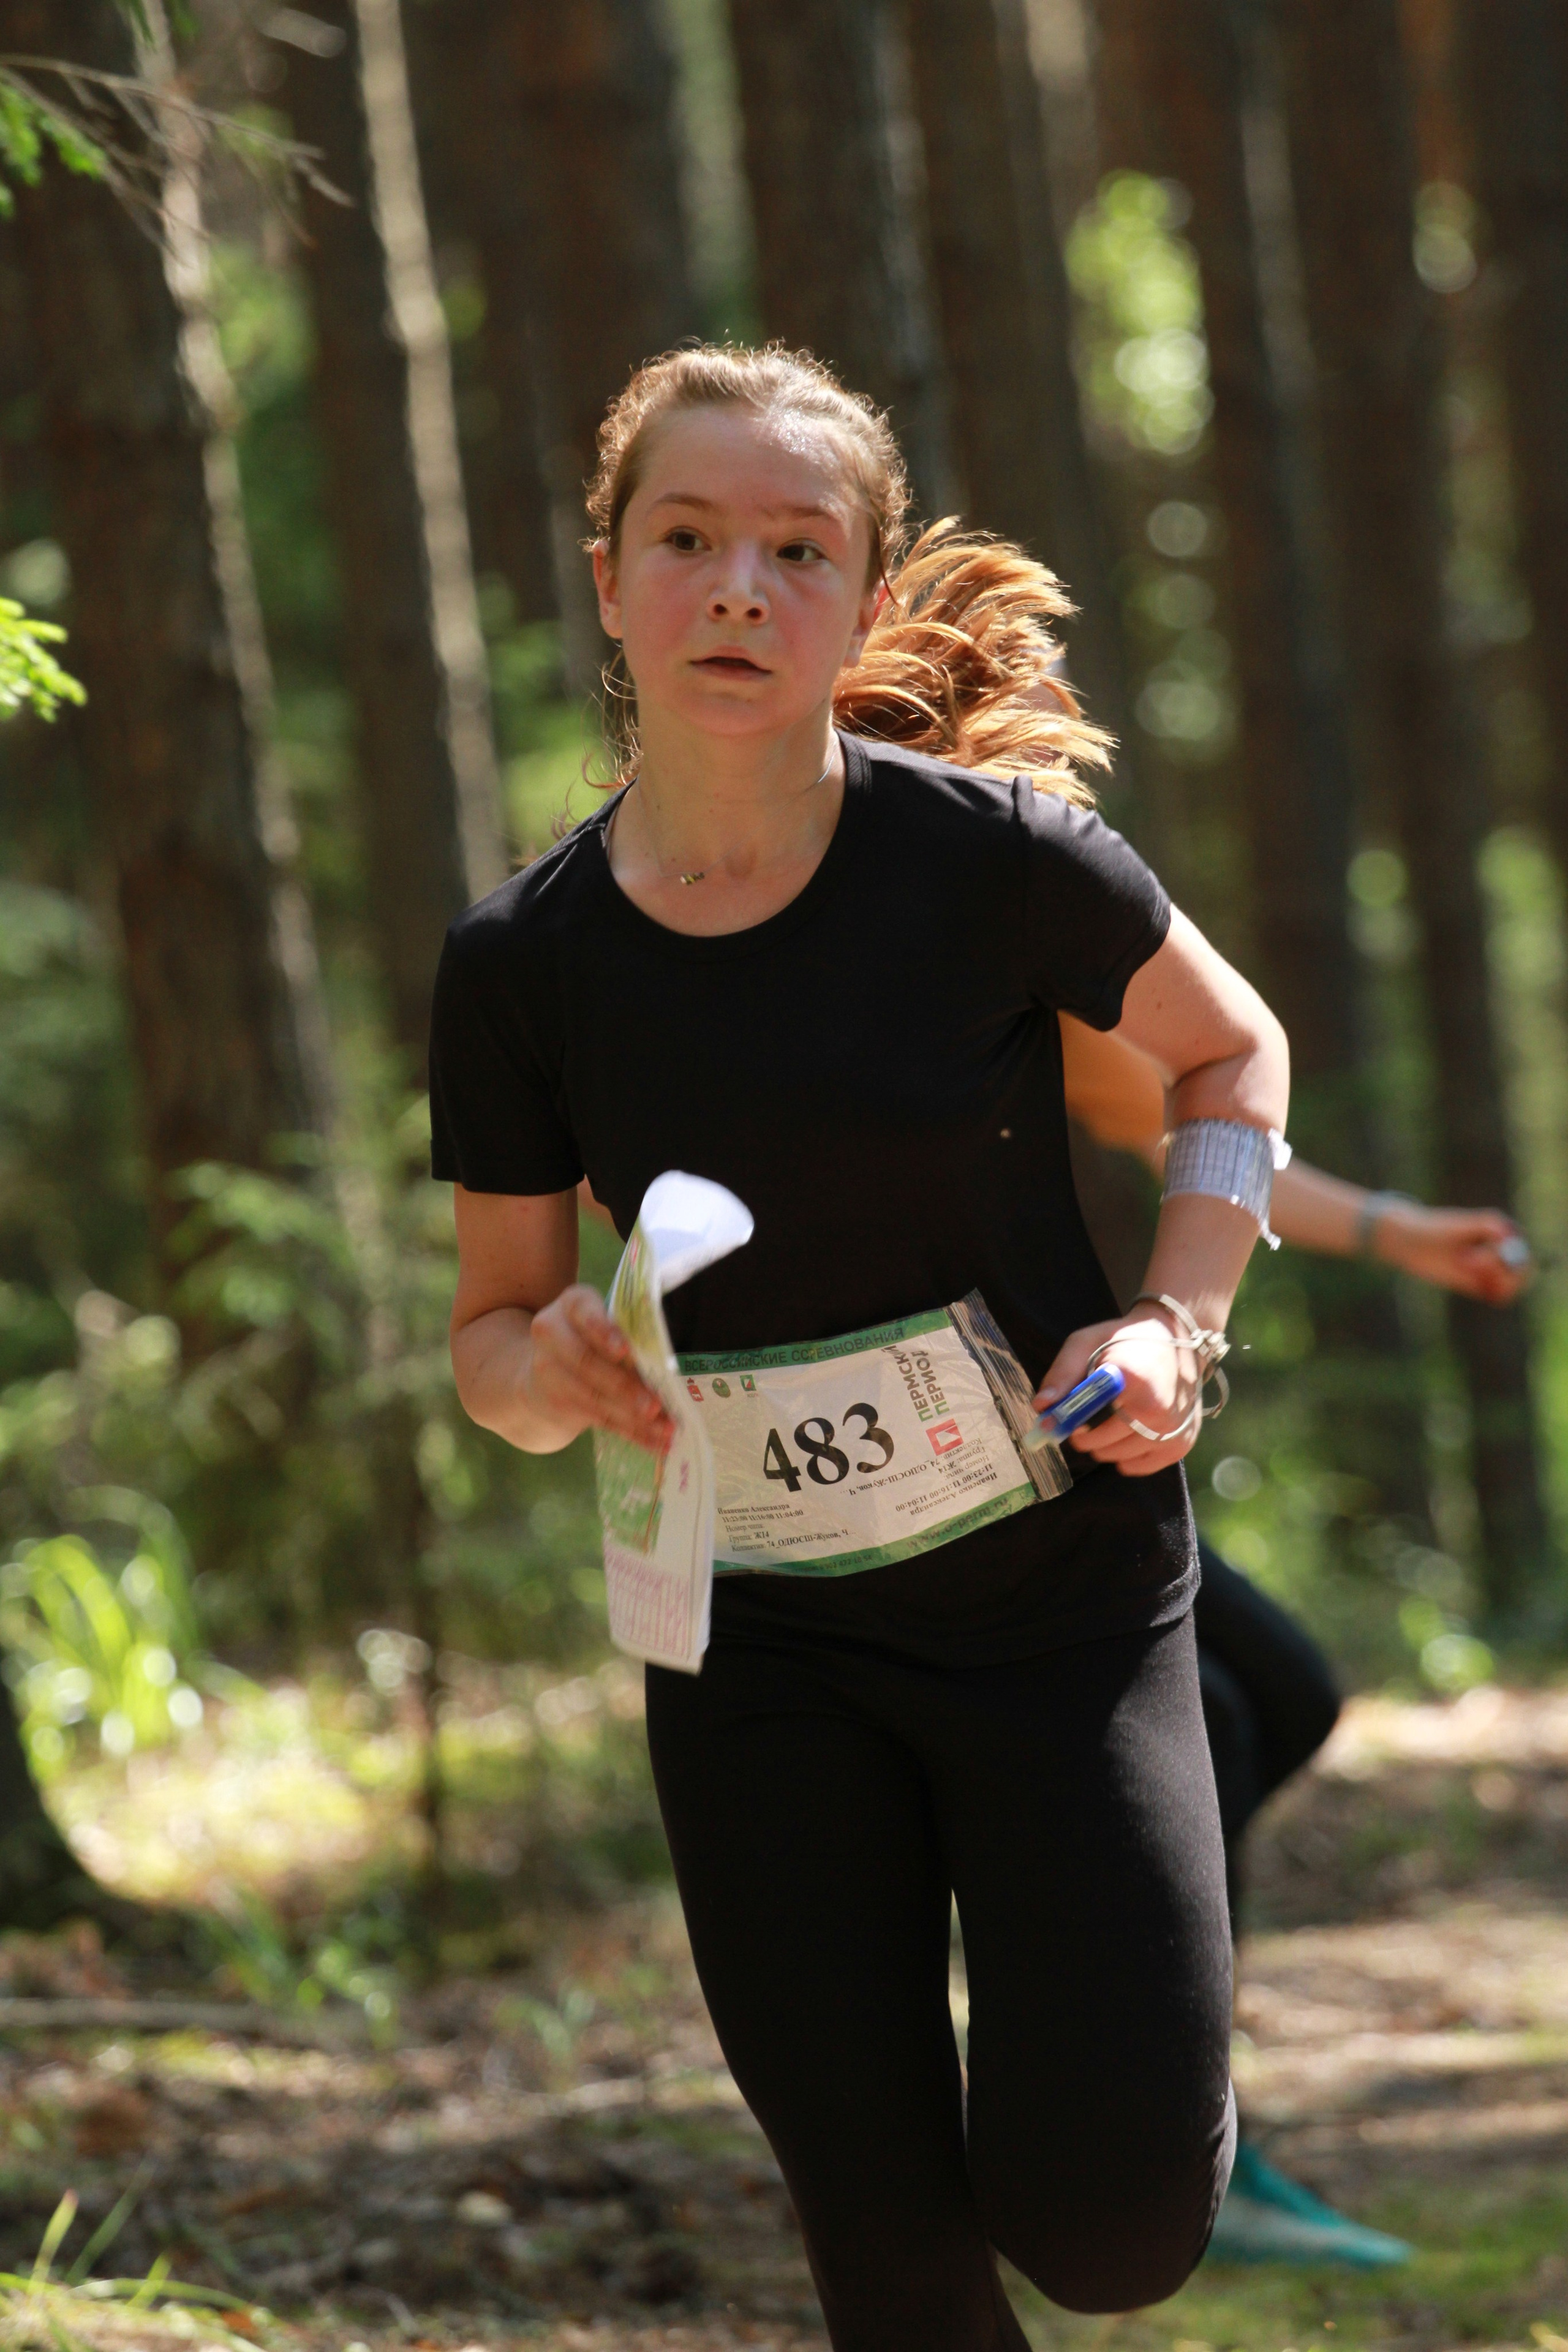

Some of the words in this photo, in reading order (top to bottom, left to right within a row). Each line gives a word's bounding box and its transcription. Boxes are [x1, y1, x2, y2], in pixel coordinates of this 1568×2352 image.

[791, 1327, 905, 1362] СОРЕВНОВАНИЯ
[763, 1402, 895, 1493] 483
[957, 1446, 986, 1464] Группа:
[938, 1461, 957, 1474] Ж14
[964, 1455, 990, 1471] Номер
[962, 1463, 993, 1484] 11:23:00
[929, 1477, 961, 1499] 11:16:00
[750, 1504, 790, 1512] Александра
[895, 1494, 928, 1512] 11:04:00
[910, 1491, 957, 1516] Александра
[775, 1509, 804, 1519] 11:04:00
[906, 1496, 1009, 1550] www.o-perm.ru
[725, 1523, 747, 1532] Номер
